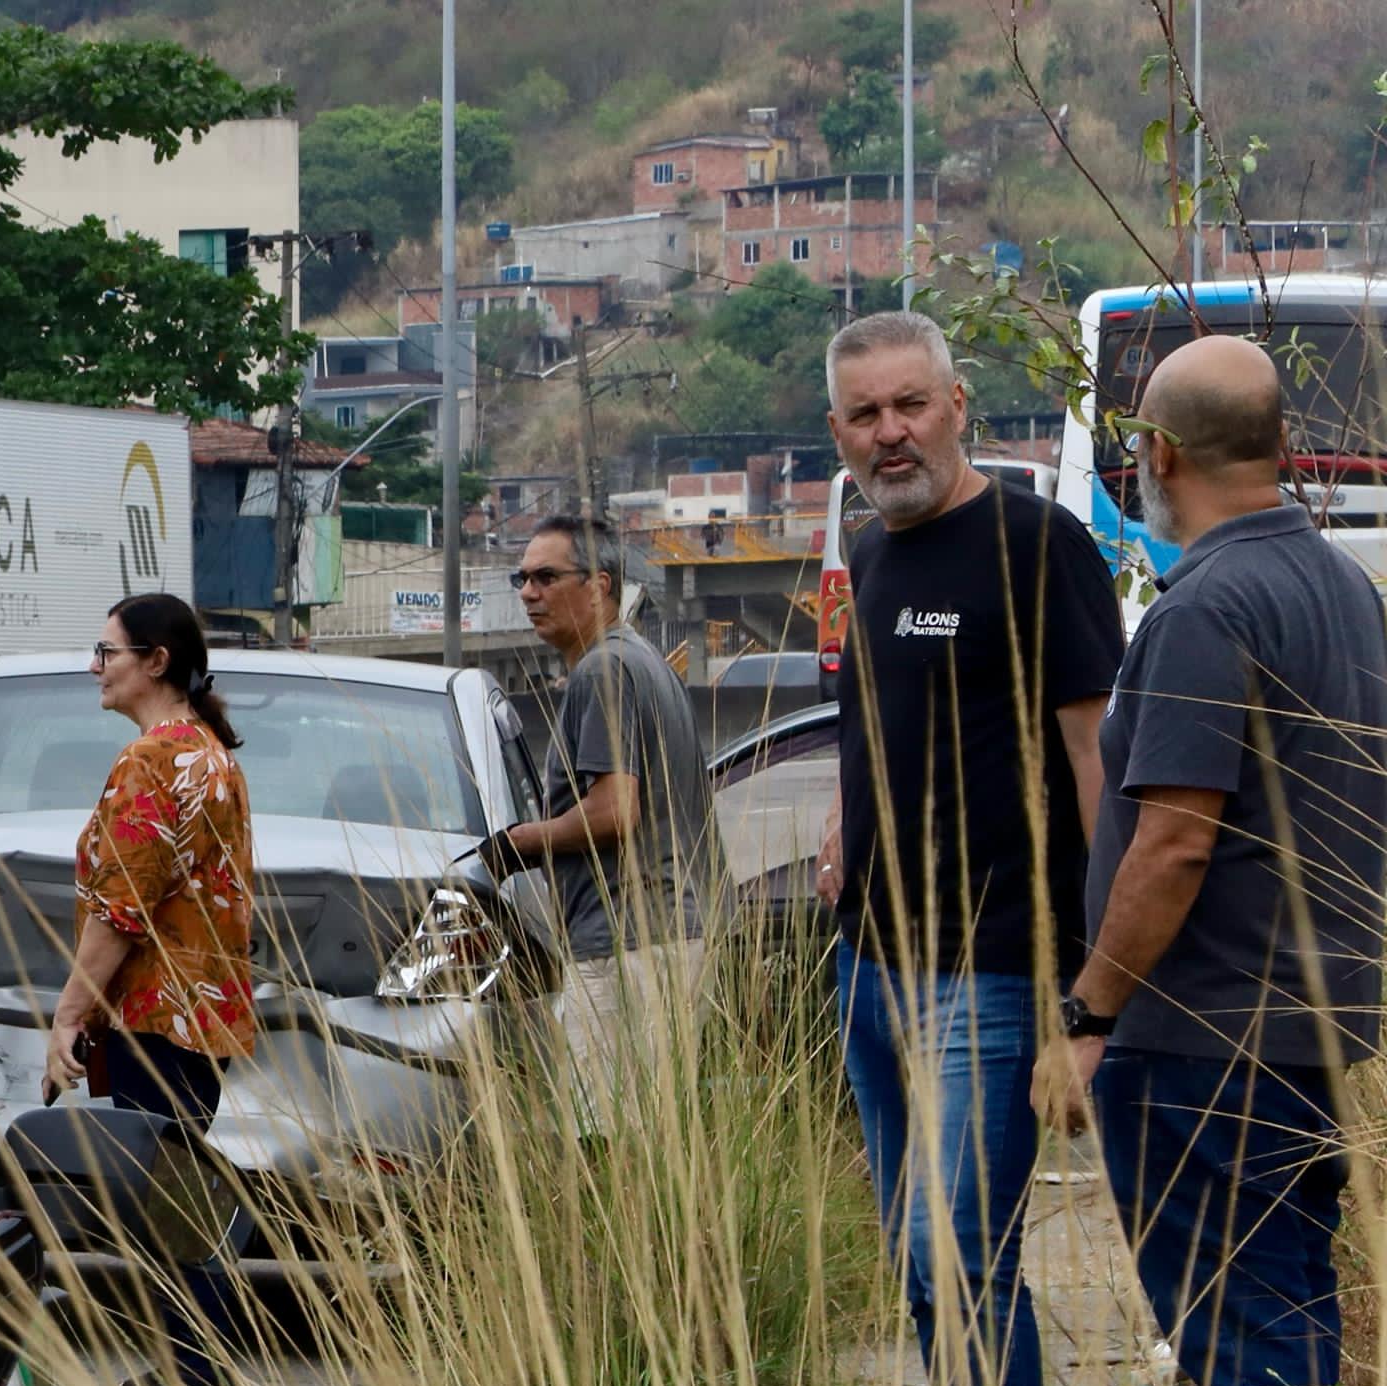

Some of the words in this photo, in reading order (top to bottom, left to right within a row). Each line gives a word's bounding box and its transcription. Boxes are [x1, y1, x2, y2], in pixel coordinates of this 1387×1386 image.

[395, 591, 441, 609] VENDO
[915, 612, 961, 627] LIONS
[913, 626, 958, 637] BATERIAS
